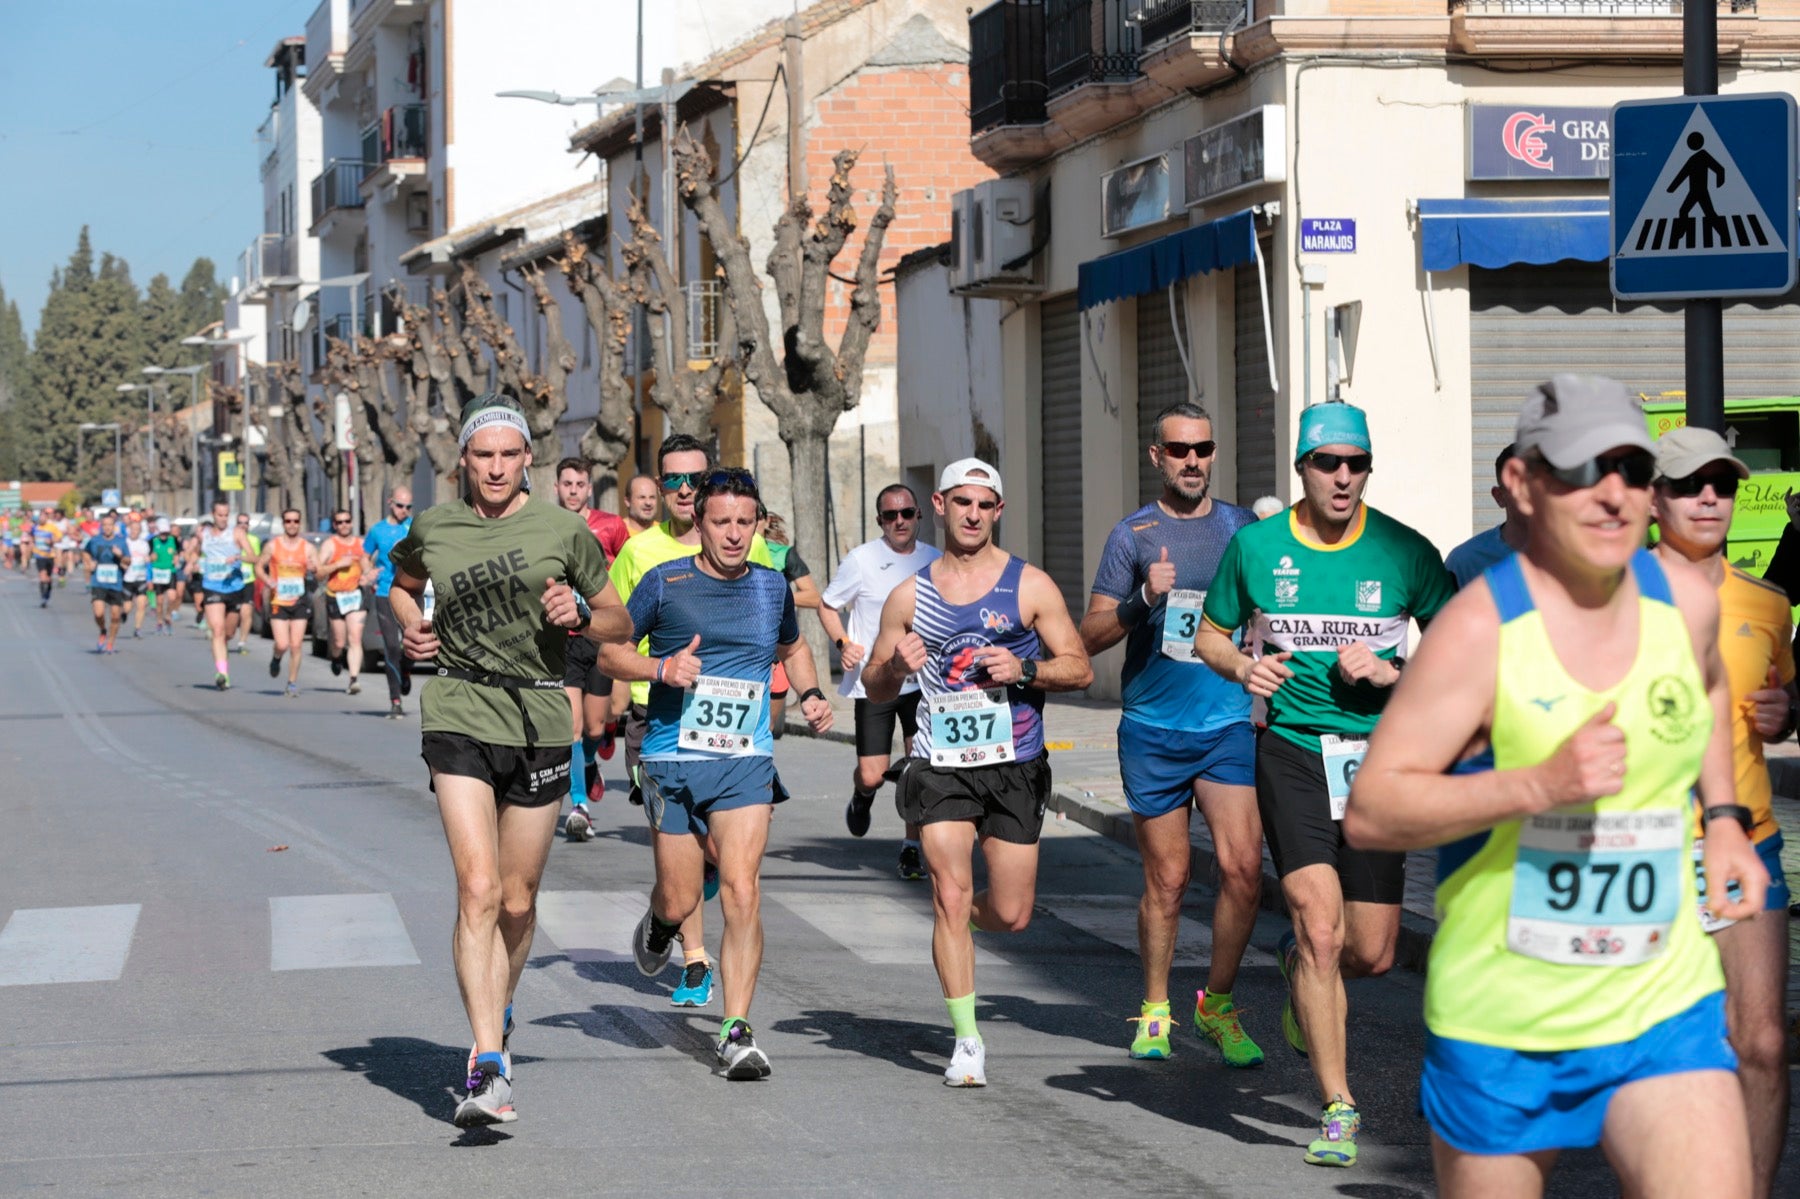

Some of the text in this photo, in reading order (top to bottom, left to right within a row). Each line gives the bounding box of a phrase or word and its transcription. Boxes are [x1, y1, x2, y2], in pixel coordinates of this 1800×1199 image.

[1581, 142, 1610, 160] DE
[1312, 220, 1343, 231] PLAZA
[1304, 235, 1354, 250] NARANJOS
[450, 548, 530, 597] BENE
[451, 598, 531, 644] TRAIL
[1269, 619, 1383, 636] CAJA RURAL
[495, 630, 532, 650] VIGILSA
[696, 700, 750, 730] 357
[944, 713, 997, 744] 337
[1547, 861, 1656, 915] 970
